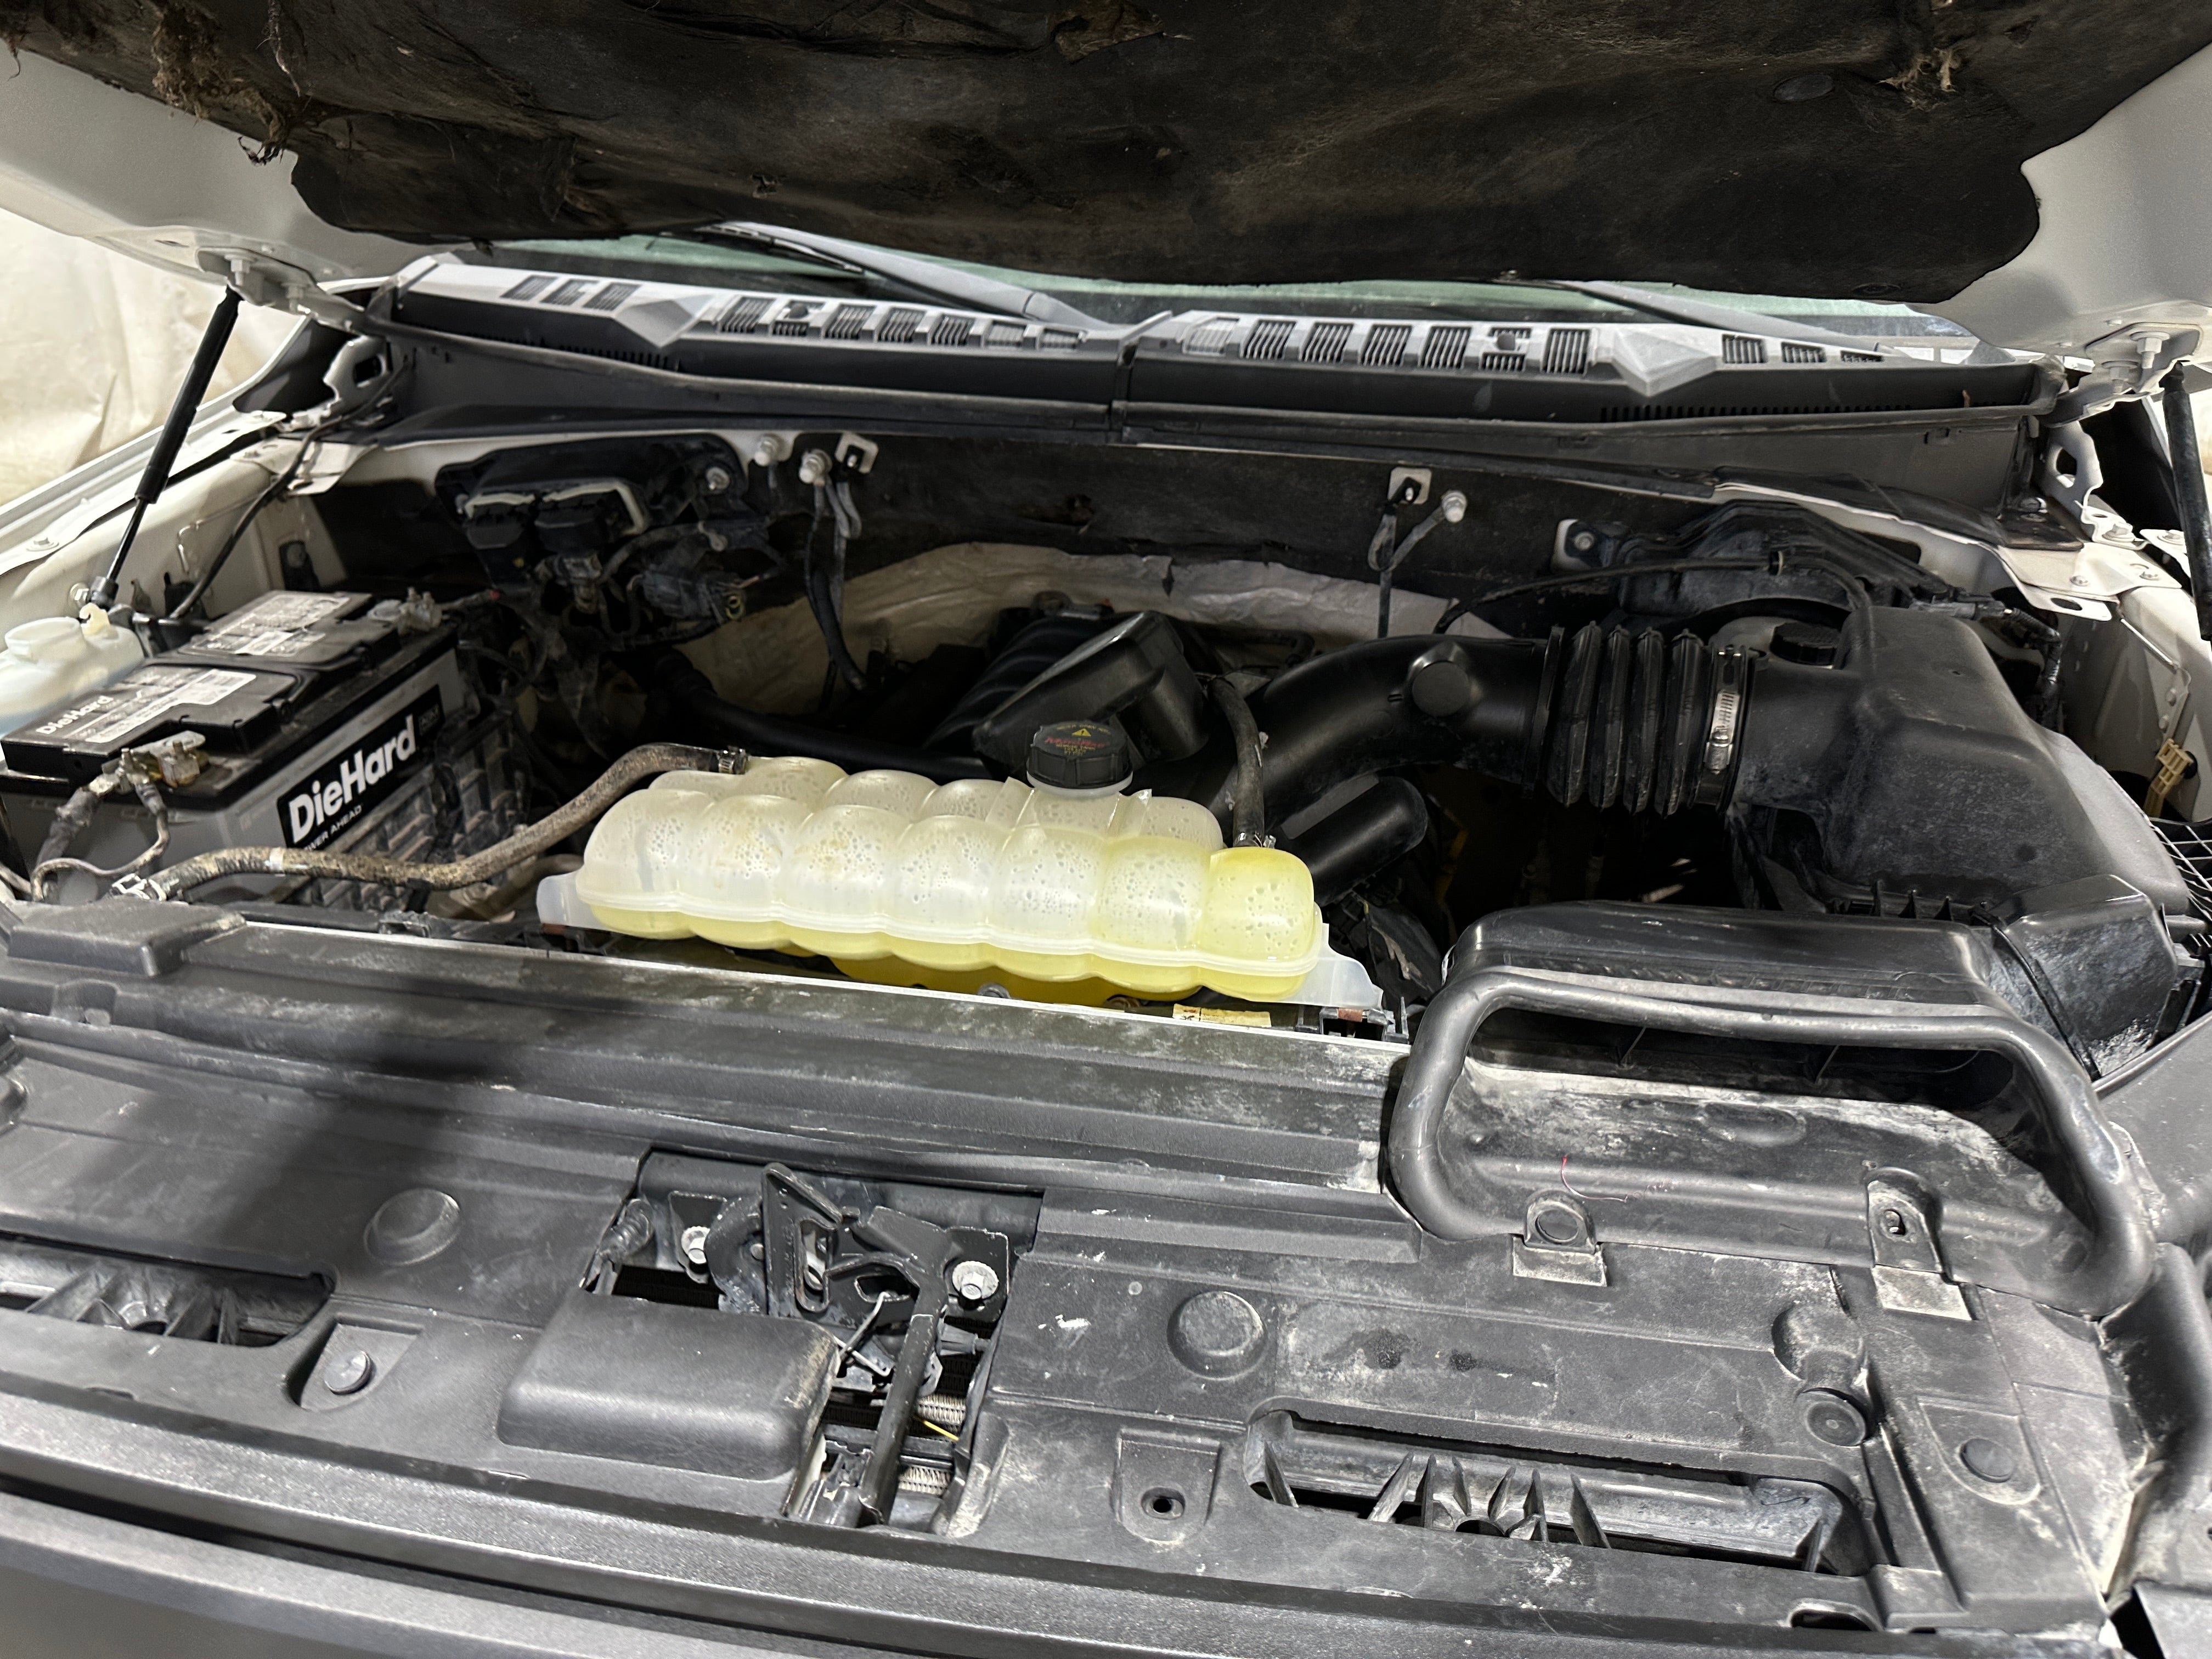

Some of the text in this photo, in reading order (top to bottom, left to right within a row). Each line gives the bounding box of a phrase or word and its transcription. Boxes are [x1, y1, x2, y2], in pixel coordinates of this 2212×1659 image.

[36, 696, 114, 734] DieHard
[289, 714, 416, 844] DieHard
[304, 804, 362, 851] WER AHEAD
